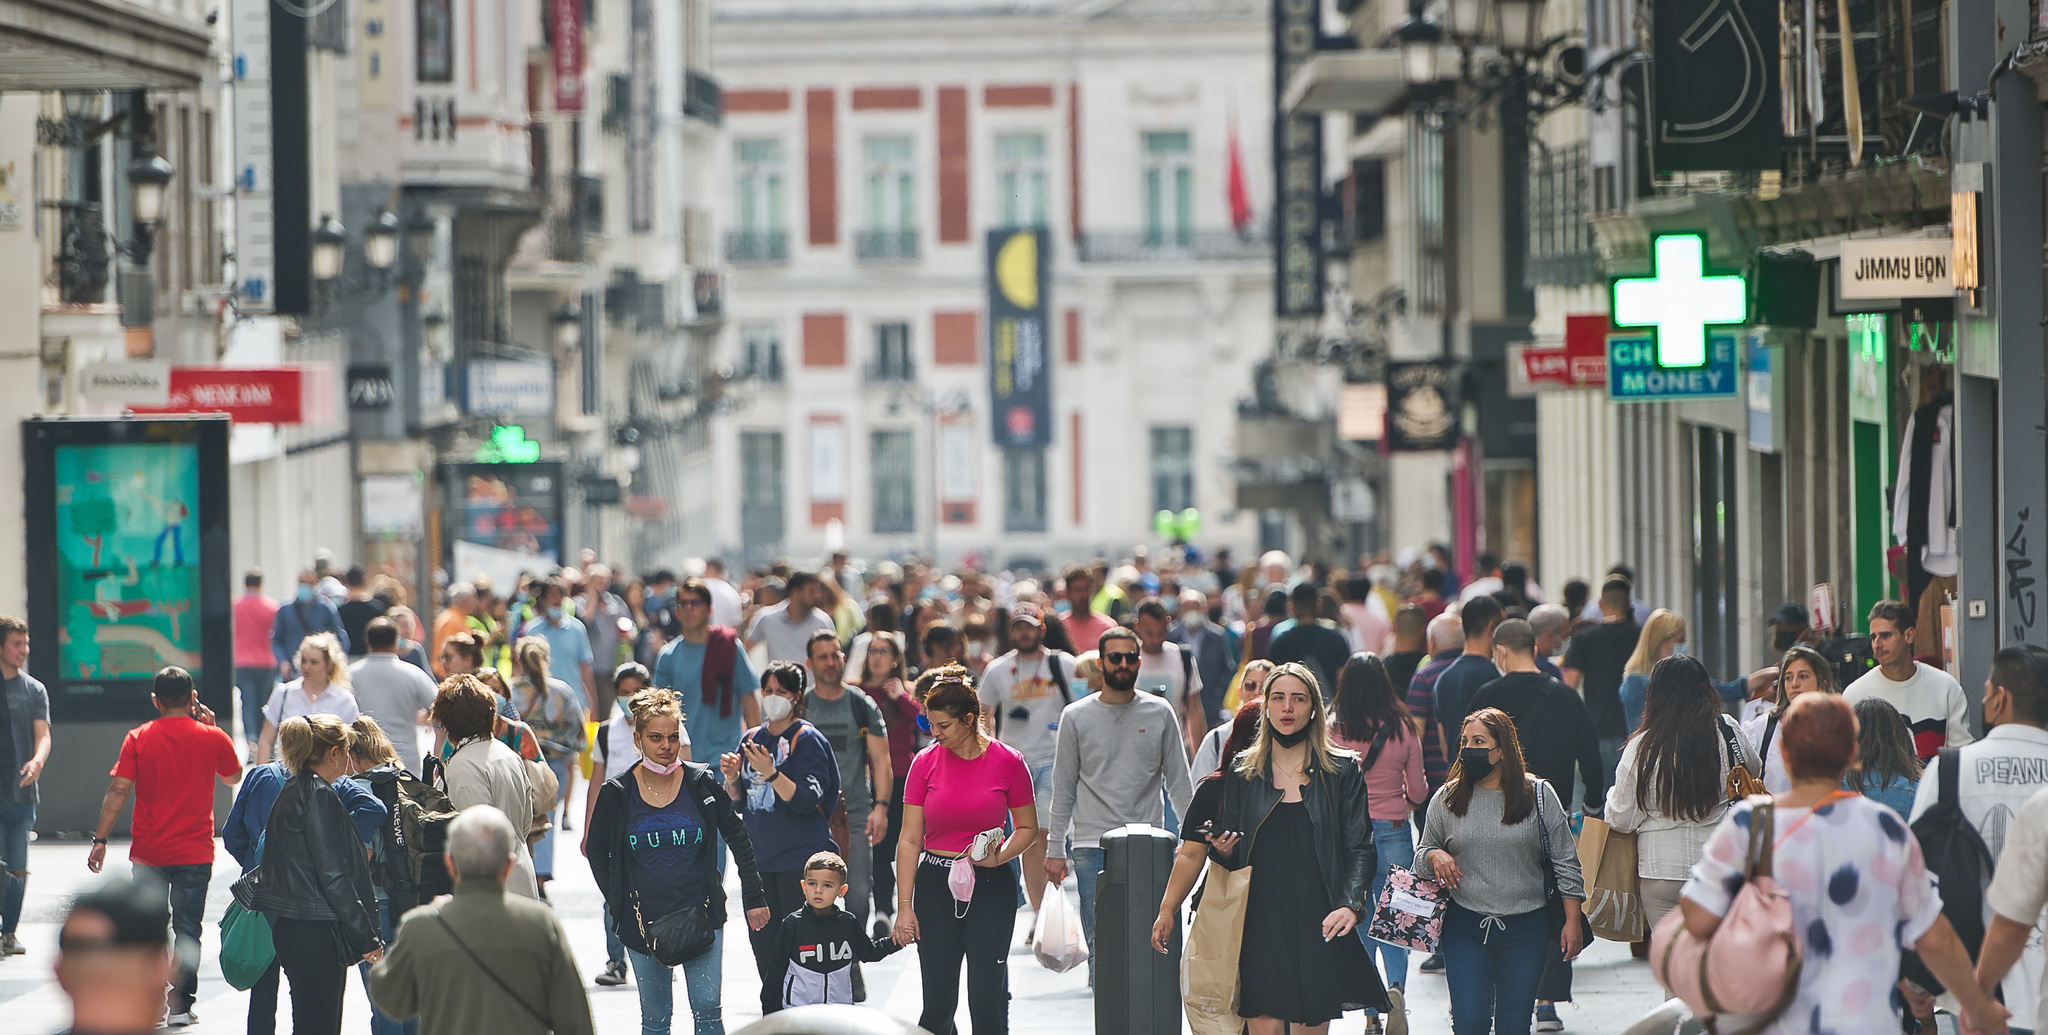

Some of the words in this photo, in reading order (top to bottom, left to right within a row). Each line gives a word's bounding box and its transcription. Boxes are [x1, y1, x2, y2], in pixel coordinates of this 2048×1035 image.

[1622, 370, 1722, 395] MONEY
[629, 827, 703, 851] PUMA
[925, 854, 953, 868] NIKE
[798, 940, 853, 964] FILA
